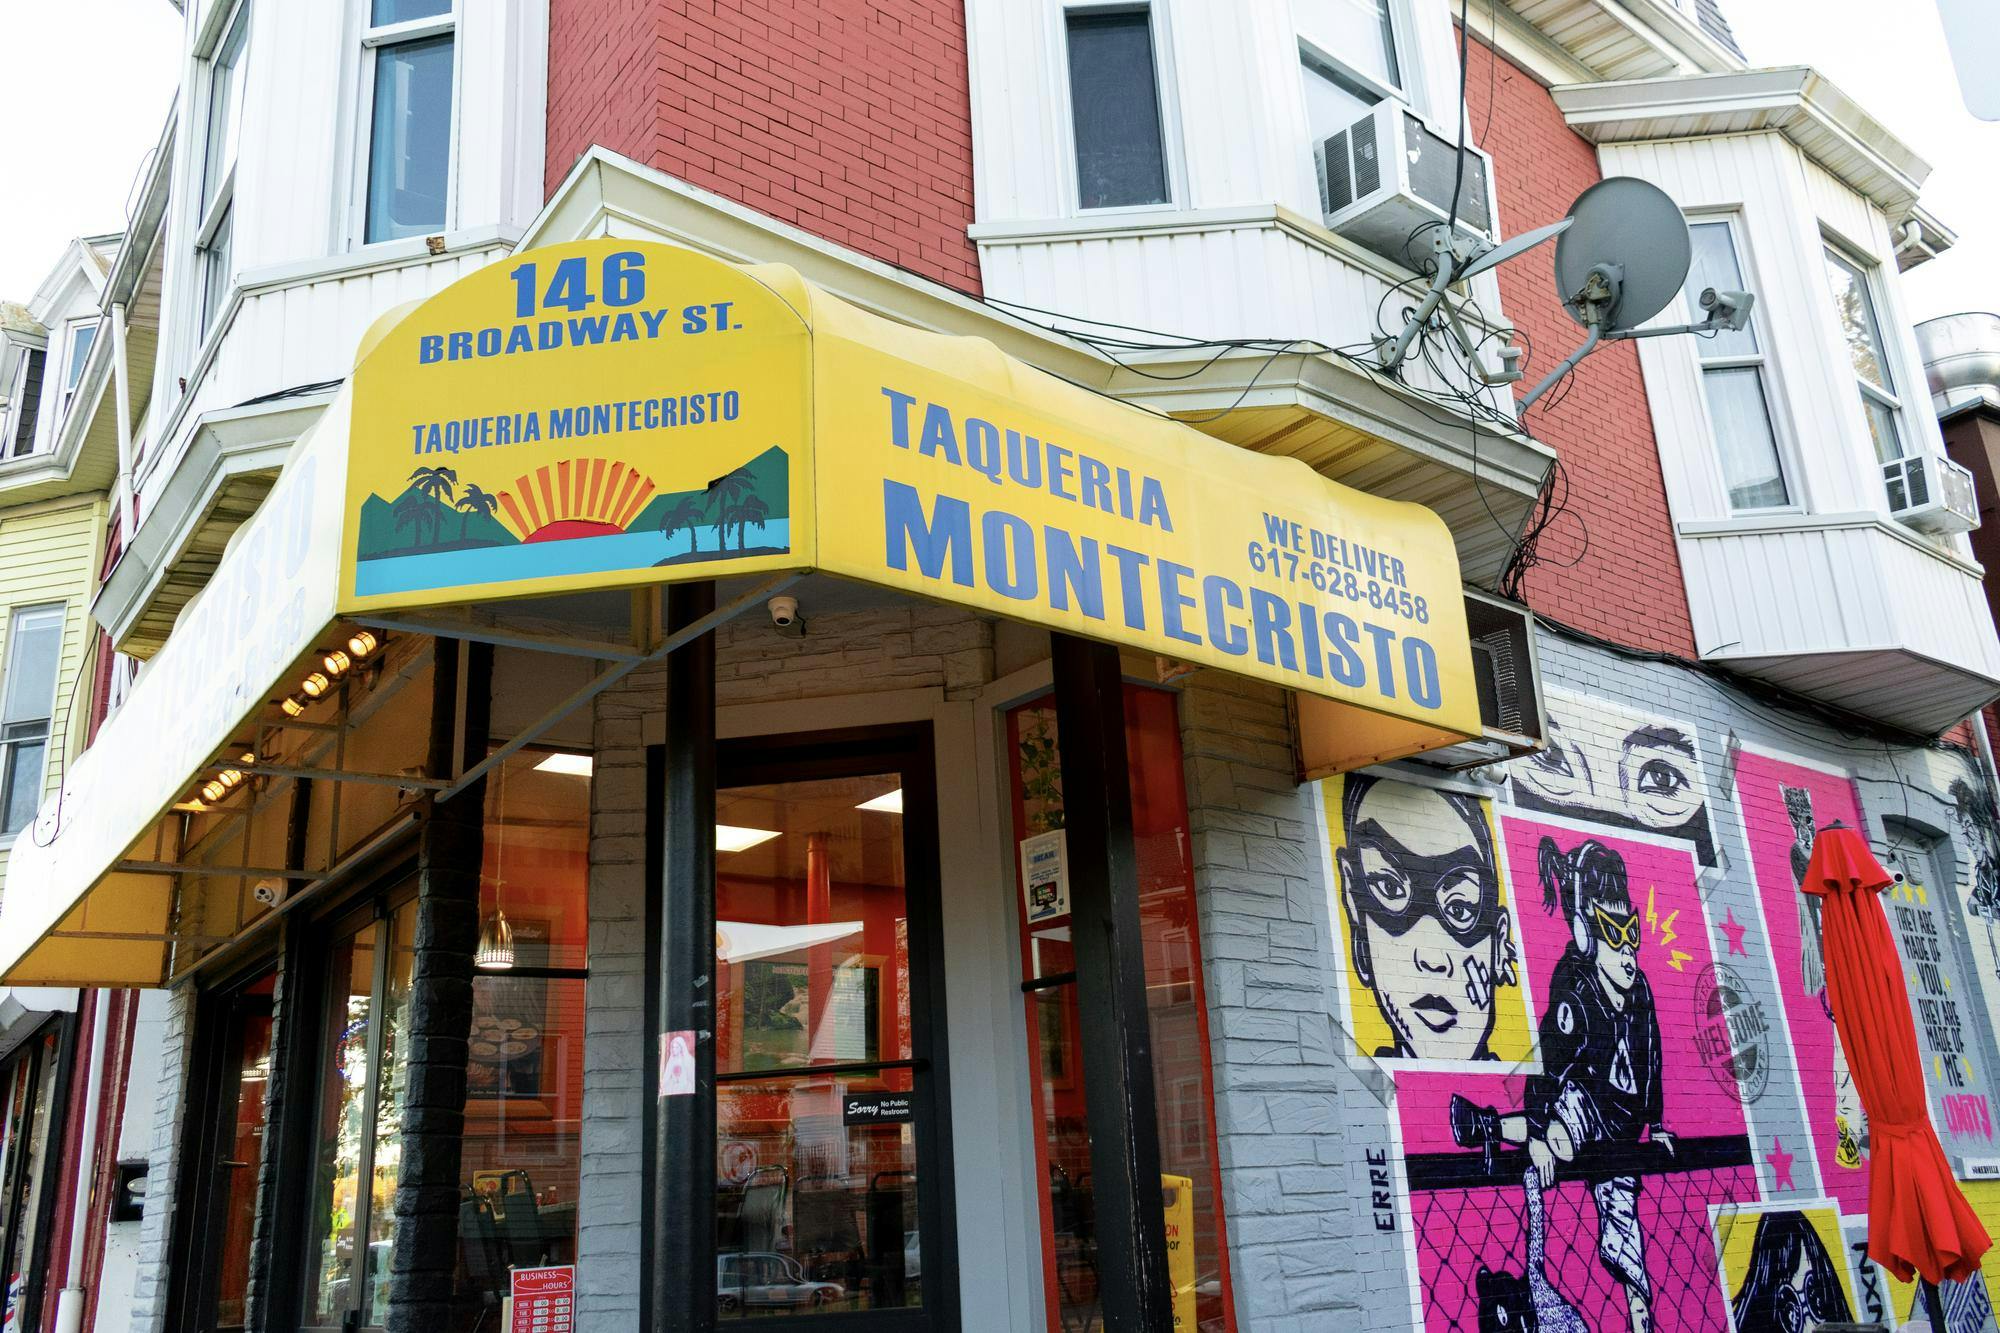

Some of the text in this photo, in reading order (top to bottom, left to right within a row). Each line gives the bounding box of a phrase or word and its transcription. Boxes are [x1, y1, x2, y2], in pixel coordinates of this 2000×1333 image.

[510, 250, 646, 318] 146
[419, 301, 743, 365] BROADWAY ST.
[412, 390, 740, 456] TAQUERIA MONTECRISTO
[881, 386, 1174, 534] TAQUERIA
[1262, 511, 1408, 589] WE DELIVER
[882, 478, 1442, 711] MONTECRISTO
[1247, 541, 1430, 626] 617-628-8458
[1895, 906, 1937, 935] THEY ARE
[1902, 934, 1941, 963] MADE OF
[1692, 1000, 1770, 1066] WELCOME
[1918, 999, 1961, 1027] THEY ARE
[1925, 1025, 1965, 1054] MADE OF
[1943, 1054, 1964, 1087] ME
[847, 1101, 879, 1116] Sorry
[890, 1099, 909, 1107] Public
[1366, 1148, 1395, 1231] ERRE
[520, 1271, 557, 1280] BUSINESS
